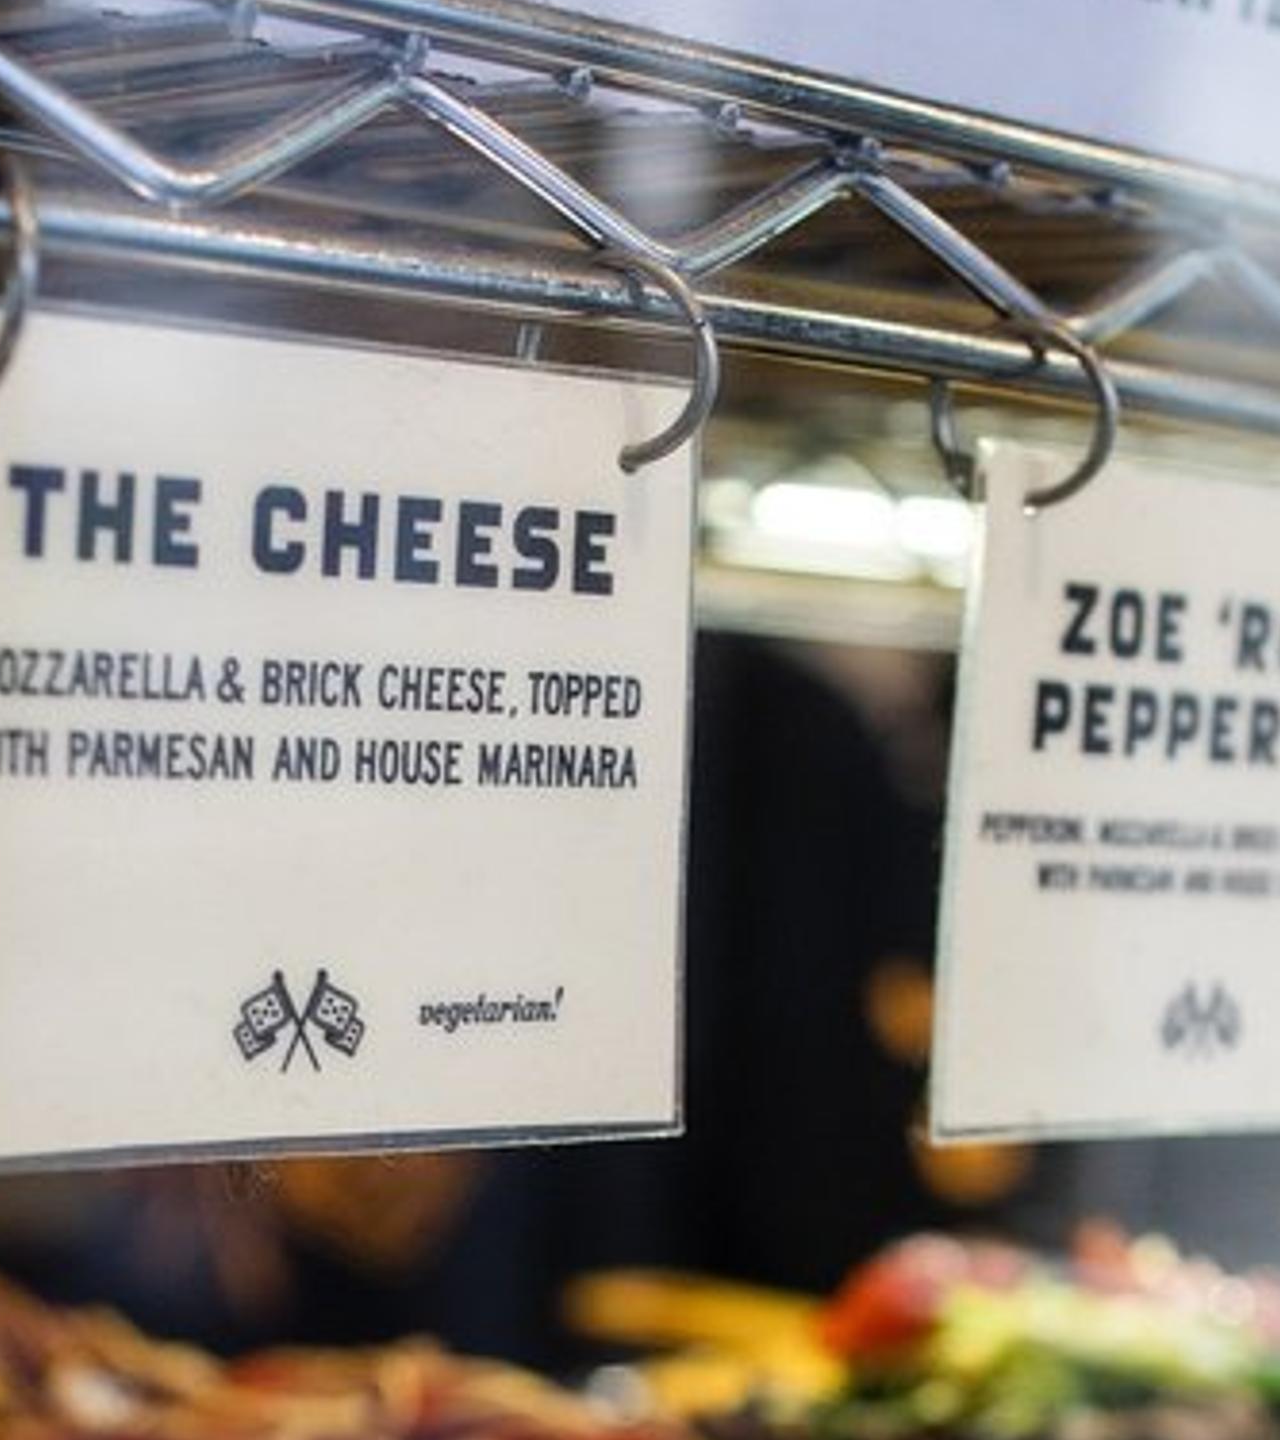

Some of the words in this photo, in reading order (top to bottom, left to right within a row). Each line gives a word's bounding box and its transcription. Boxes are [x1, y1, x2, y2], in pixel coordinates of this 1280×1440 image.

[7, 462, 203, 567] THE
[250, 484, 617, 596] CHEESE
[1060, 582, 1187, 663] ZOE
[216, 664, 245, 704] &
[261, 662, 363, 709] BRICK
[377, 665, 518, 720] CHEESE,
[528, 671, 642, 719] TOPPED
[68, 731, 255, 783] PARMESAN
[272, 736, 342, 785] AND
[353, 739, 463, 787] HOUSE
[476, 742, 638, 789] MARINARA
[417, 985, 566, 1035] vegetarian!
